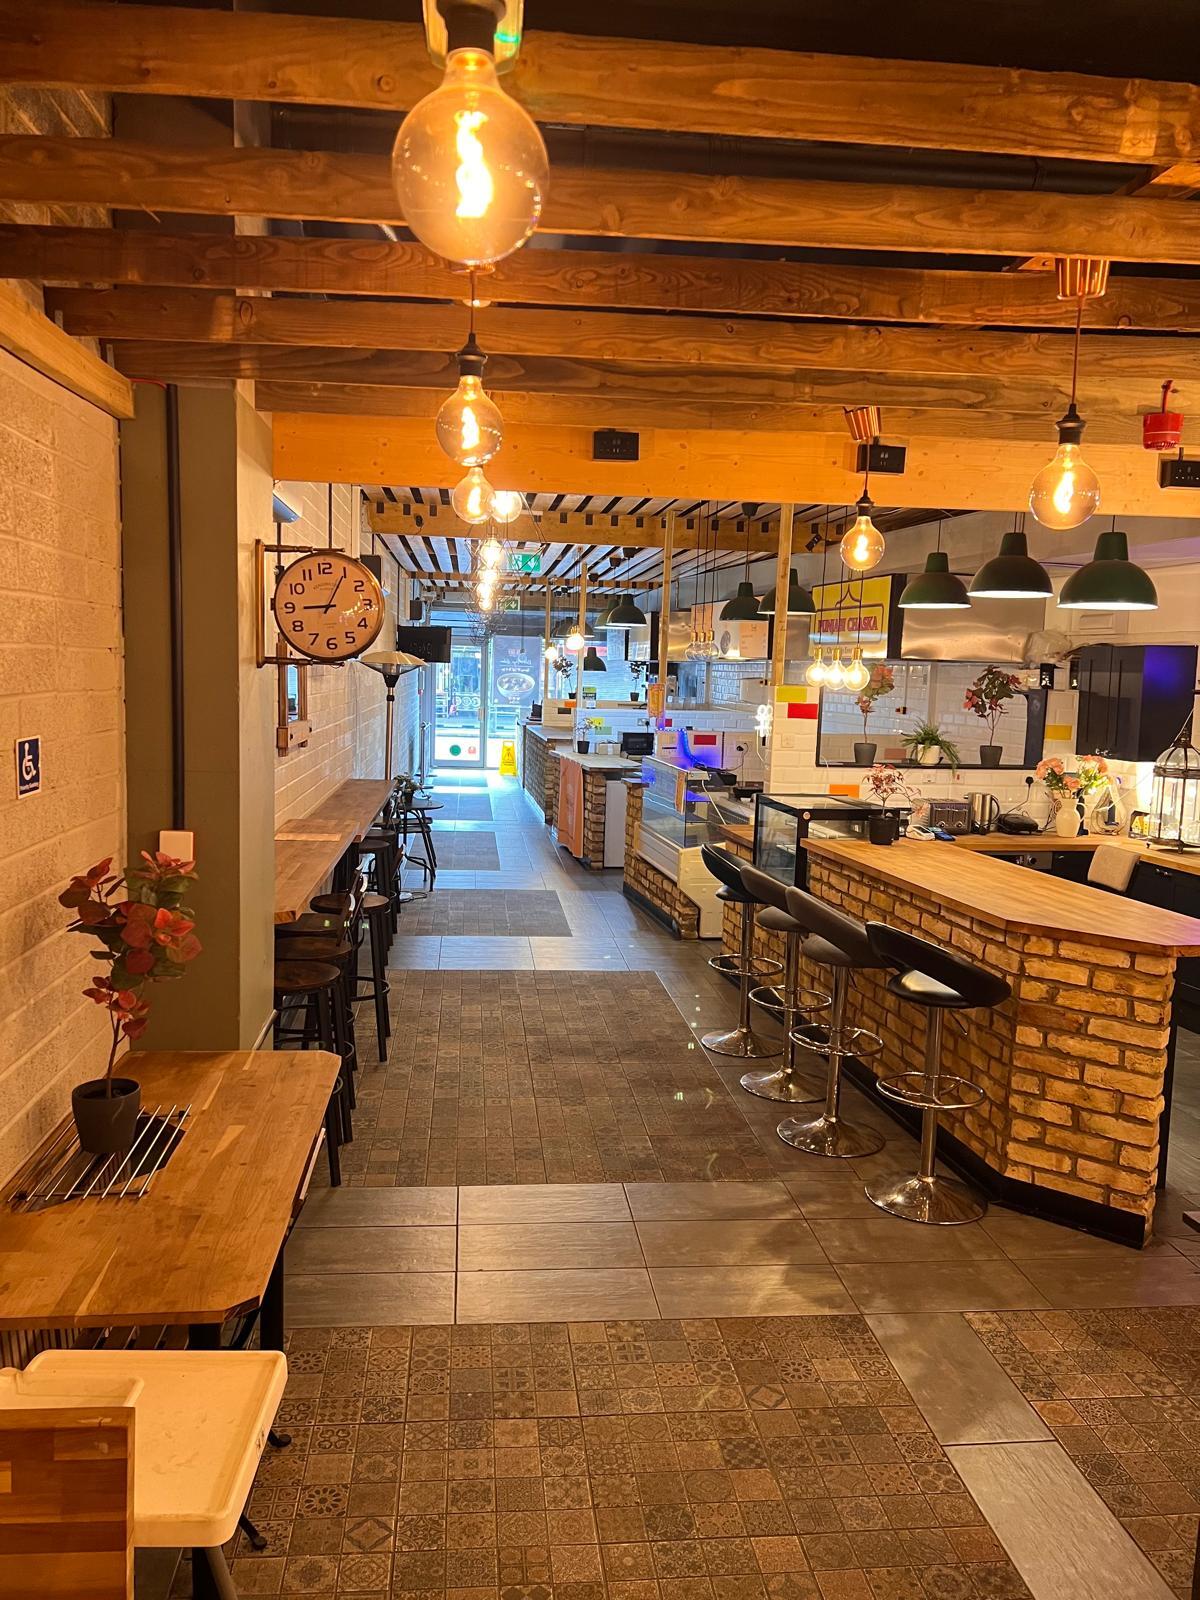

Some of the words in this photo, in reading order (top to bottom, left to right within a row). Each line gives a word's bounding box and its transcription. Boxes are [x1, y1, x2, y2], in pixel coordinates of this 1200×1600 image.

[317, 562, 333, 575] 12
[343, 567, 347, 579] 1
[302, 569, 312, 581] 11
[289, 582, 305, 595] 10
[353, 580, 365, 592] 2
[284, 602, 295, 614] 9
[362, 598, 373, 611] 3
[292, 620, 303, 632] 8
[357, 617, 368, 629] 4
[308, 633, 319, 646] 7
[326, 637, 338, 650] 6
[345, 632, 356, 644] 5
